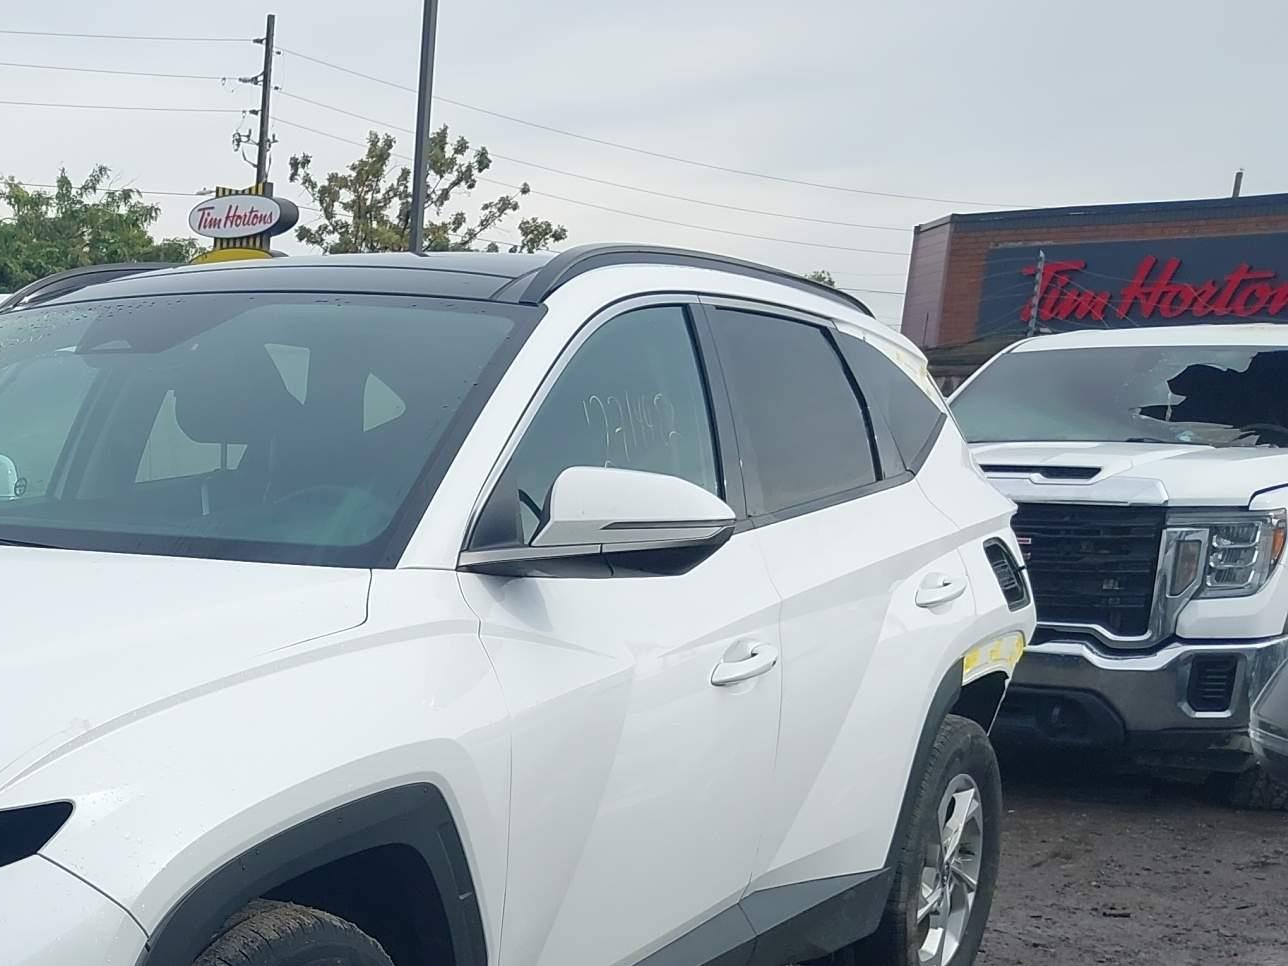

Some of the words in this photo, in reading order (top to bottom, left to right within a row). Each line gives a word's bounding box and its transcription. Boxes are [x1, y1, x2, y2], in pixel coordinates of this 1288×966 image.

[197, 206, 222, 231] Tim
[223, 204, 273, 229] Hortons
[1021, 260, 1111, 321] Tim
